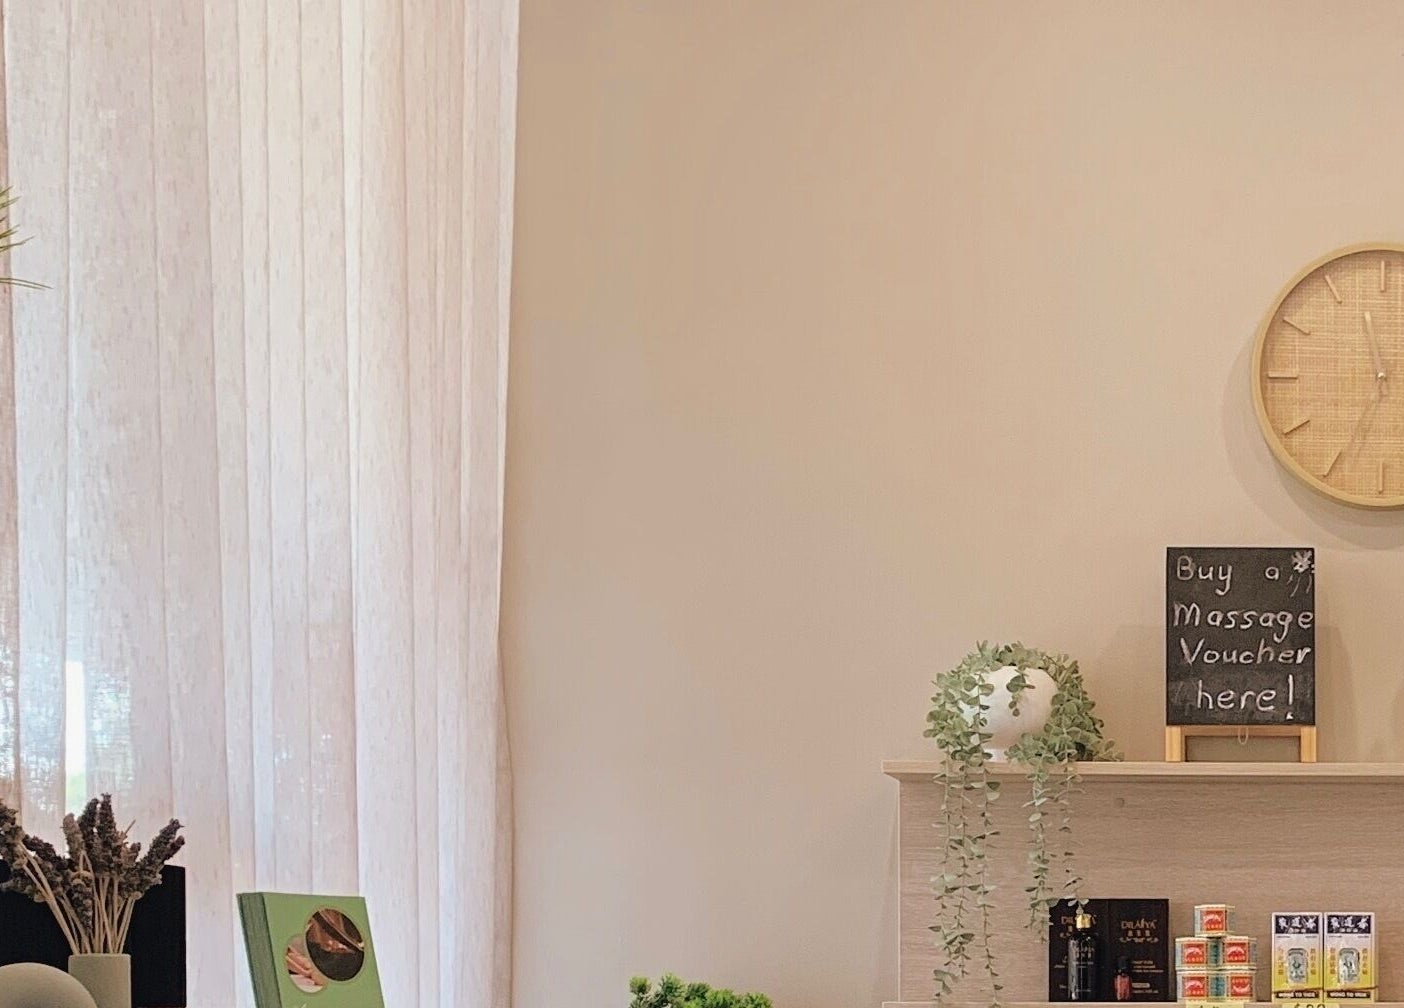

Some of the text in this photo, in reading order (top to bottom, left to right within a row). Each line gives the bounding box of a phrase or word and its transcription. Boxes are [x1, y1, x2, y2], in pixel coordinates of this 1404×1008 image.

[1176, 554, 1280, 596] Buy a
[1173, 602, 1314, 644] Massage
[1180, 637, 1312, 666] Voucher
[1197, 673, 1294, 720] here!
